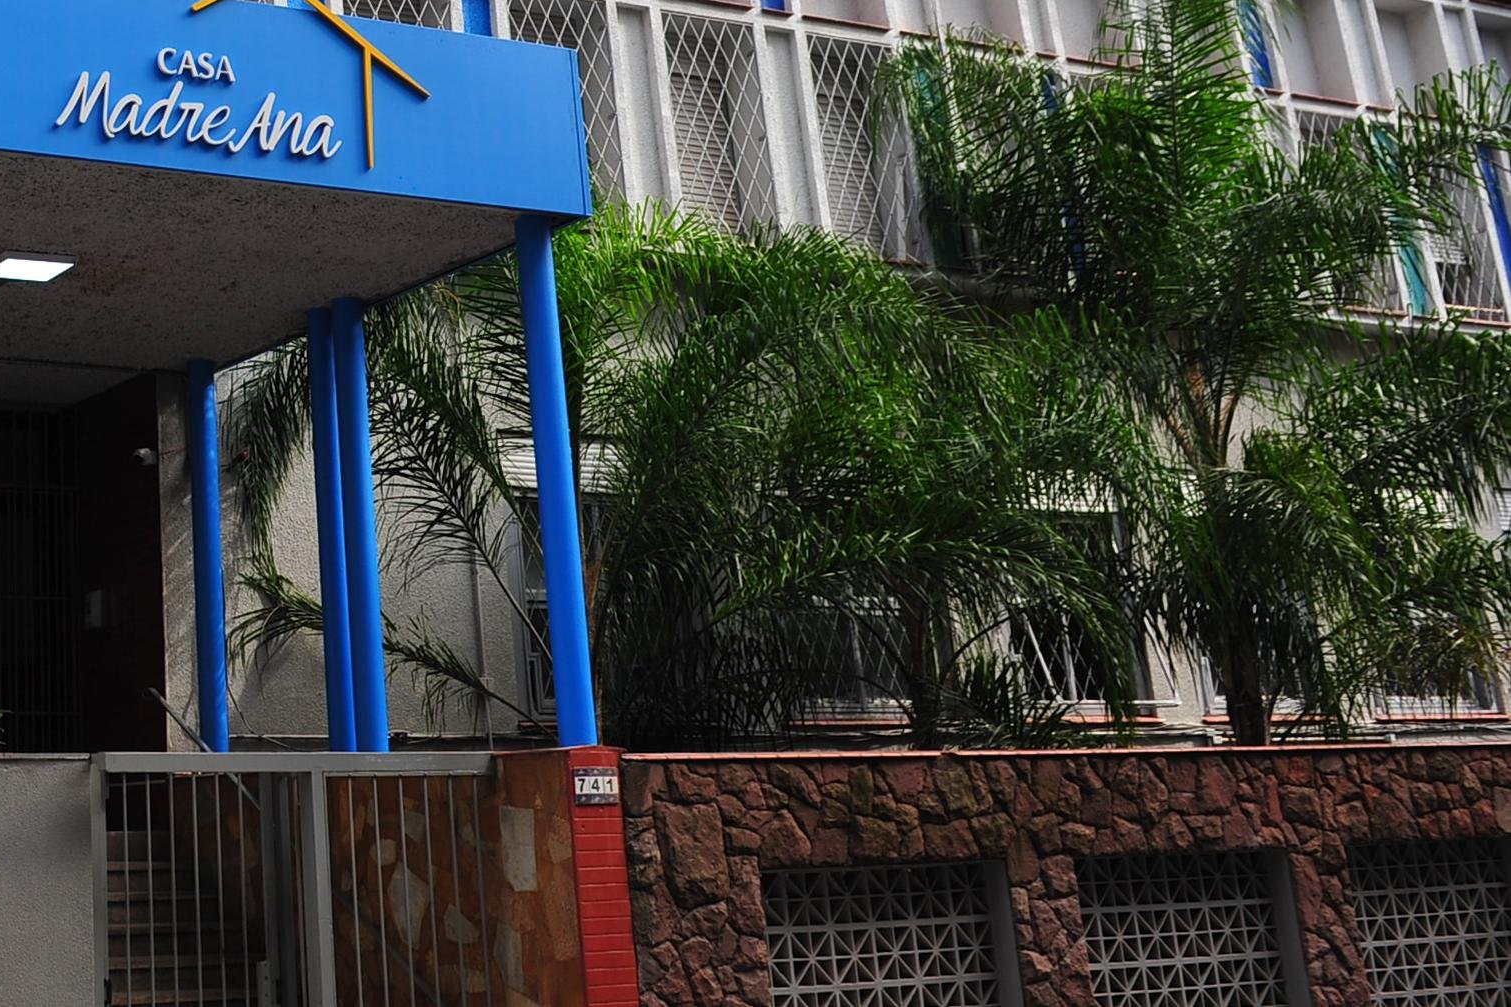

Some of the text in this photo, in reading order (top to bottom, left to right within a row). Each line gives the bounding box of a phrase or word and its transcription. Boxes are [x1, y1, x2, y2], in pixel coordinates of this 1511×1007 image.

[157, 47, 237, 83] CASA
[55, 71, 343, 159] Madre Ana
[577, 777, 613, 793] 741
